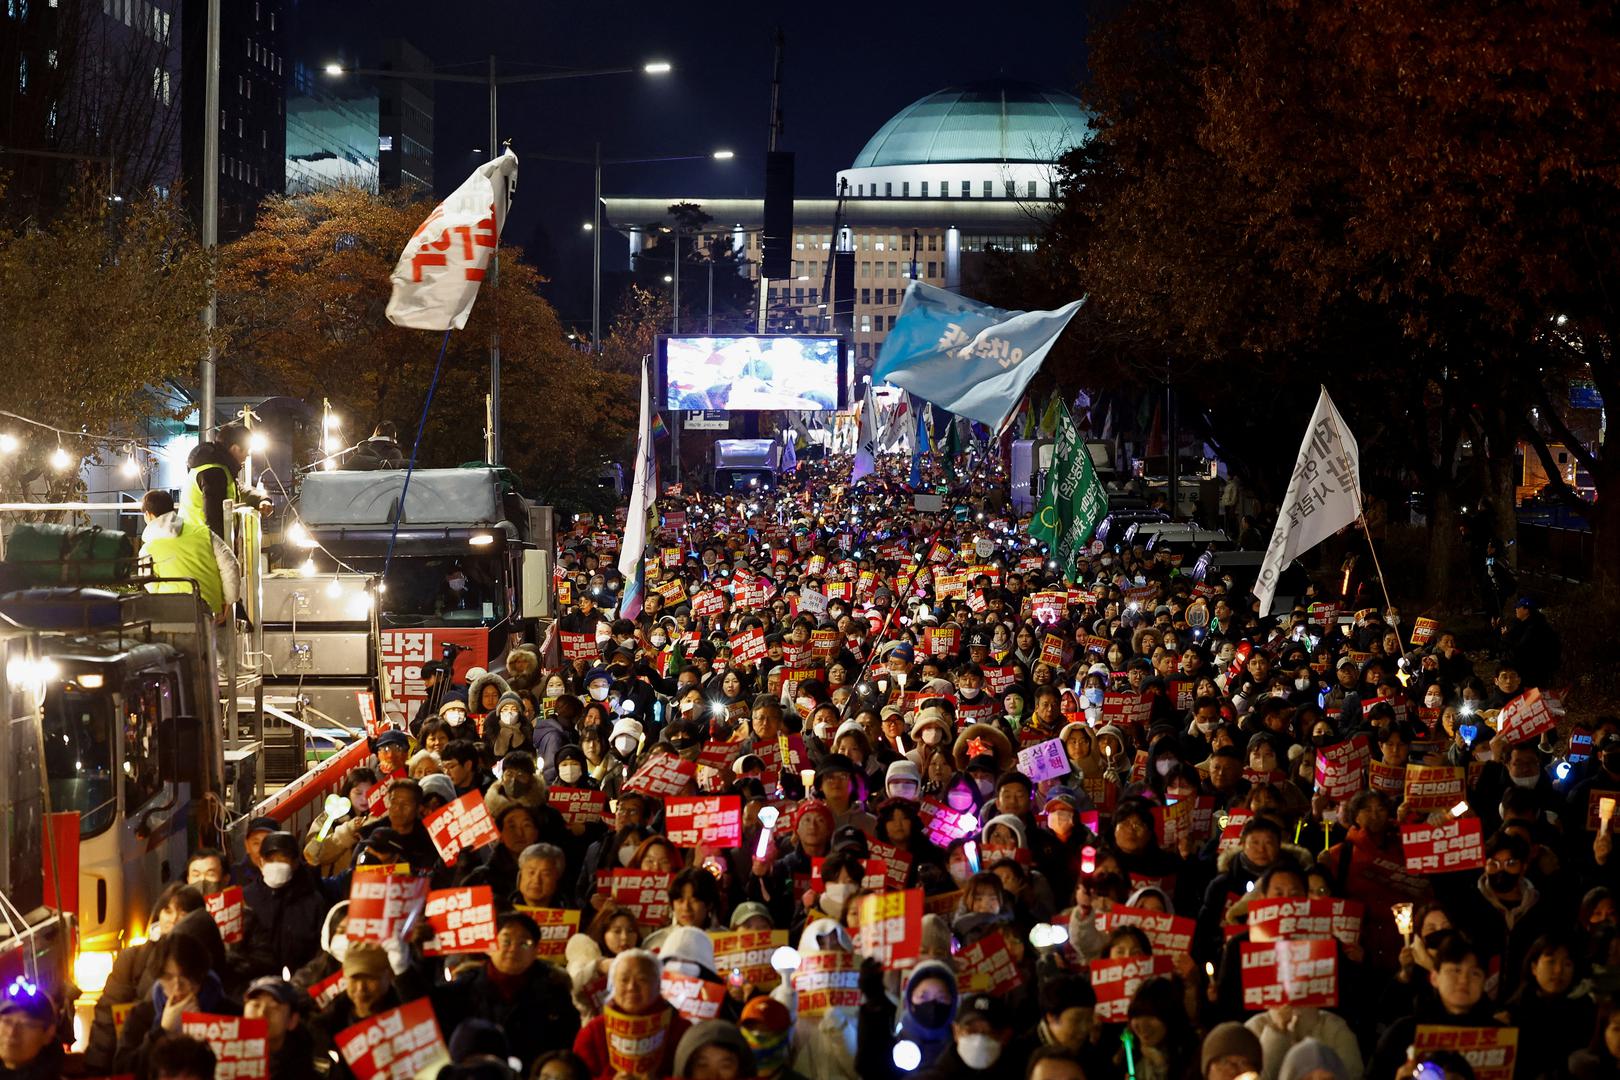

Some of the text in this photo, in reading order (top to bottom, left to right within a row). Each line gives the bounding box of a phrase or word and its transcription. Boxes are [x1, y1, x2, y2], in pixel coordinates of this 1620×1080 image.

[560, 634, 585, 643] 내란수괴
[931, 628, 955, 638] 내란죄
[1104, 695, 1141, 705] 내란수괴
[1410, 781, 1460, 795] 국민의힘
[666, 796, 720, 817] 내란수괴
[428, 798, 465, 839] 내란수괴
[447, 803, 487, 838] 윤석열
[693, 809, 739, 829] 윤석열
[667, 824, 739, 844] 즉각 탄핵!
[1402, 821, 1459, 845] 내란수괴
[1433, 832, 1480, 854] 윤석열
[1407, 846, 1482, 869] 즉각 탄핵!
[614, 874, 669, 889] 내란수괴
[447, 904, 493, 930] 윤석열
[1111, 914, 1173, 932] 내란수괴
[1248, 899, 1311, 926] 내란수괴
[458, 922, 494, 946] 탄핵!
[1279, 917, 1332, 934] 윤석열
[1091, 957, 1154, 985] 내란수괴
[1244, 976, 1335, 1005] 즉각 탄핵!
[372, 1019, 437, 1070] 윤석열
